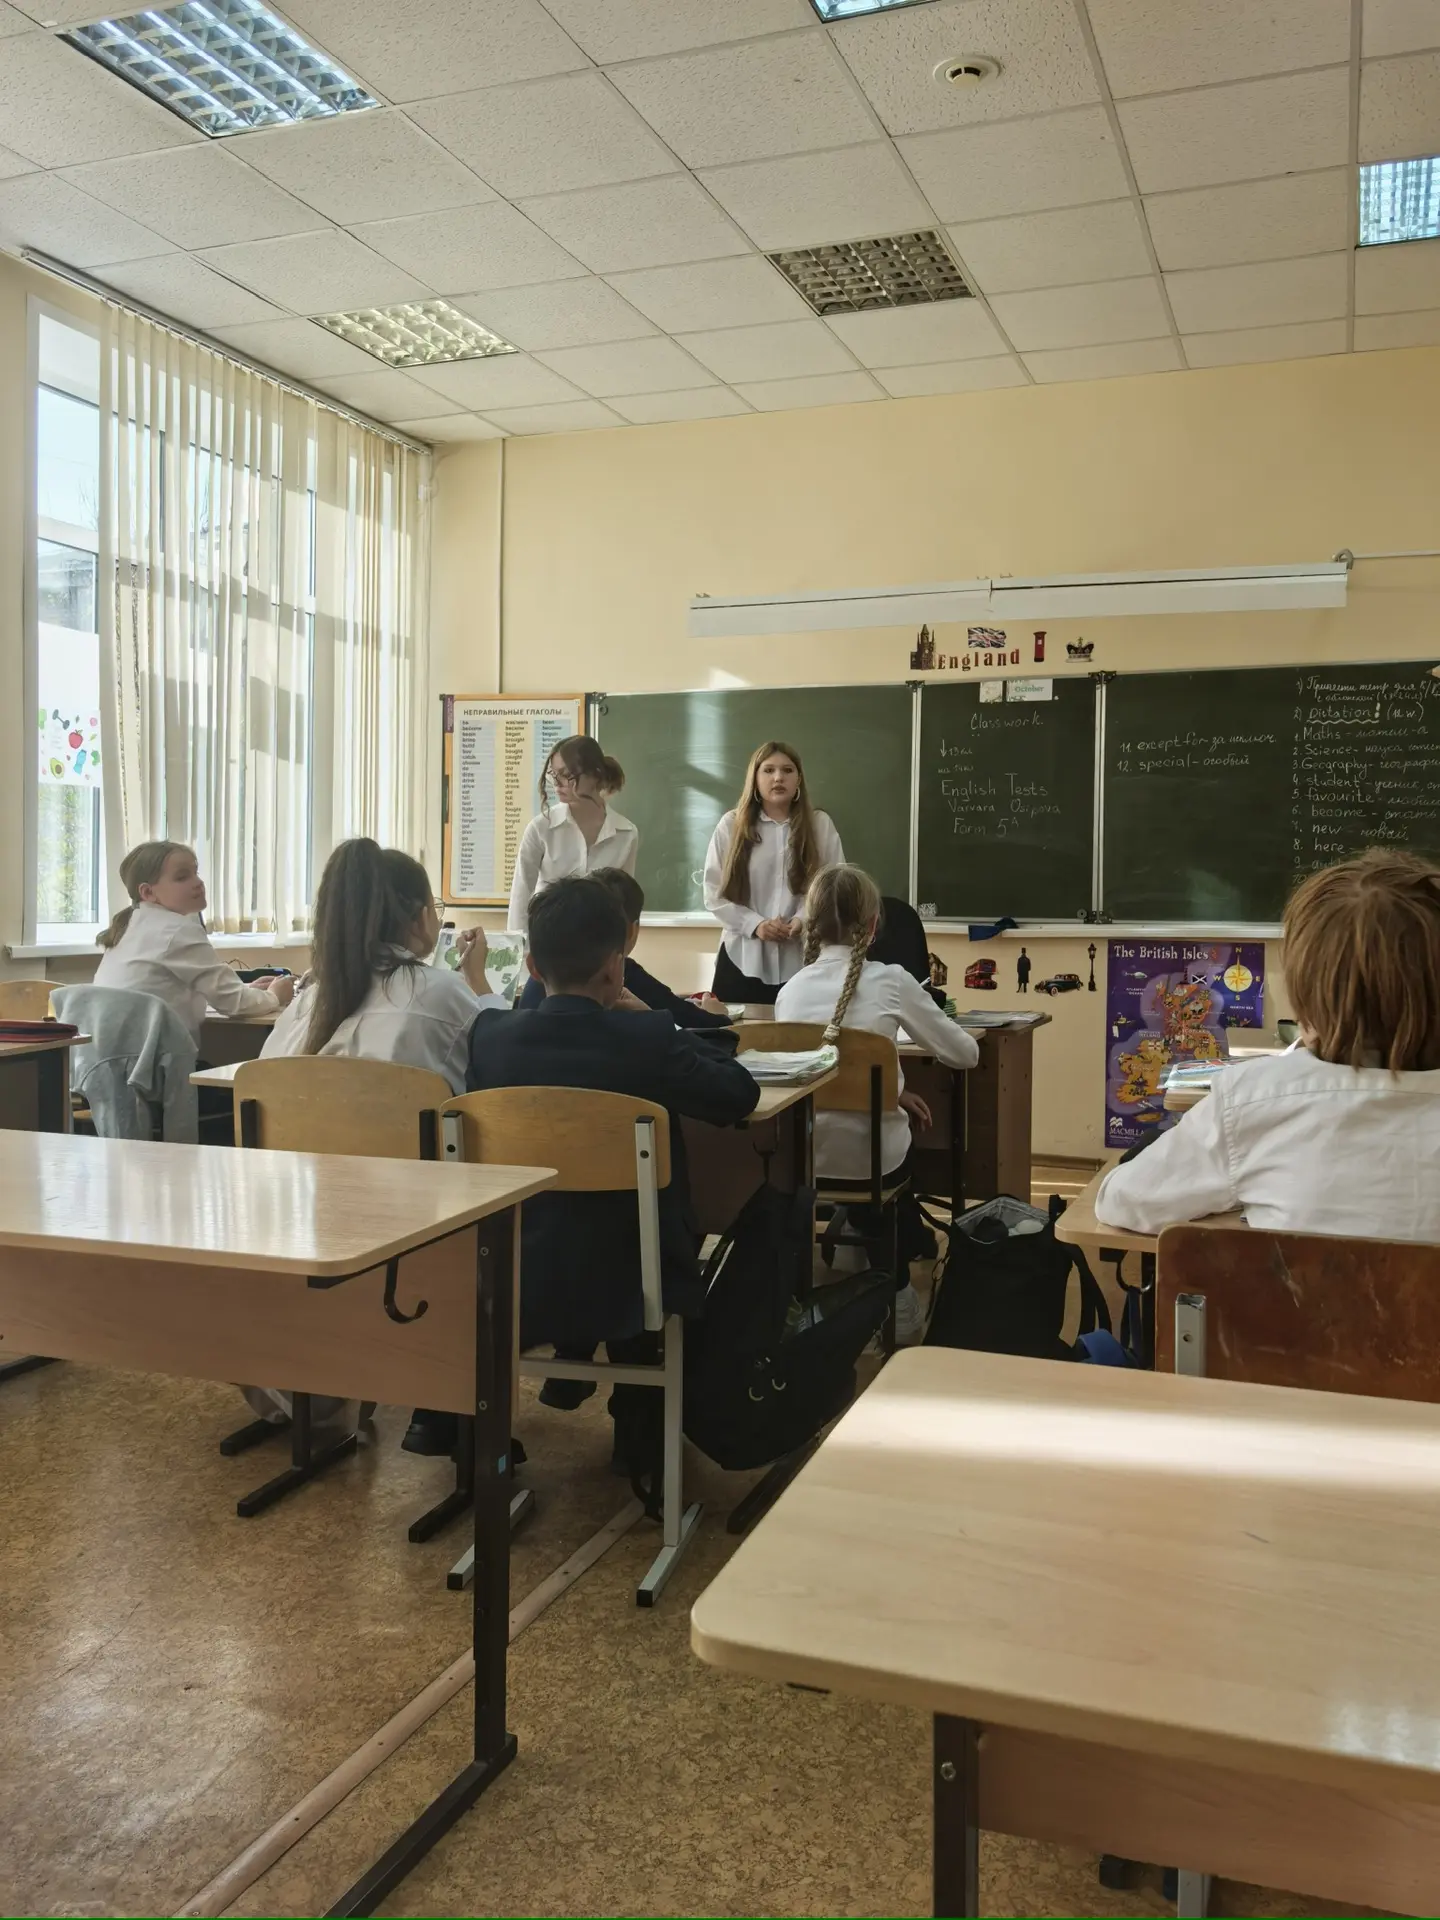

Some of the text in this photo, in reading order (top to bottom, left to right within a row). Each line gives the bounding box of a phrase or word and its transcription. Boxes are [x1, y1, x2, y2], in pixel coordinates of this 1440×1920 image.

[937, 648, 1020, 671] England
[1014, 684, 1044, 692] October
[1304, 726, 1341, 740] Maths
[1137, 734, 1182, 751] except
[941, 773, 1048, 802] English Tests
[1306, 774, 1360, 788] student
[1304, 788, 1375, 804] favourite
[948, 798, 1062, 818] Varvara Osipova
[1311, 804, 1366, 818] become
[954, 818, 986, 836] Form
[1312, 824, 1342, 834] new
[1314, 838, 1346, 854] here
[1114, 944, 1208, 960] The British Isles
[502, 973, 512, 984] 5
[1109, 1128, 1144, 1137] MACMILLA
